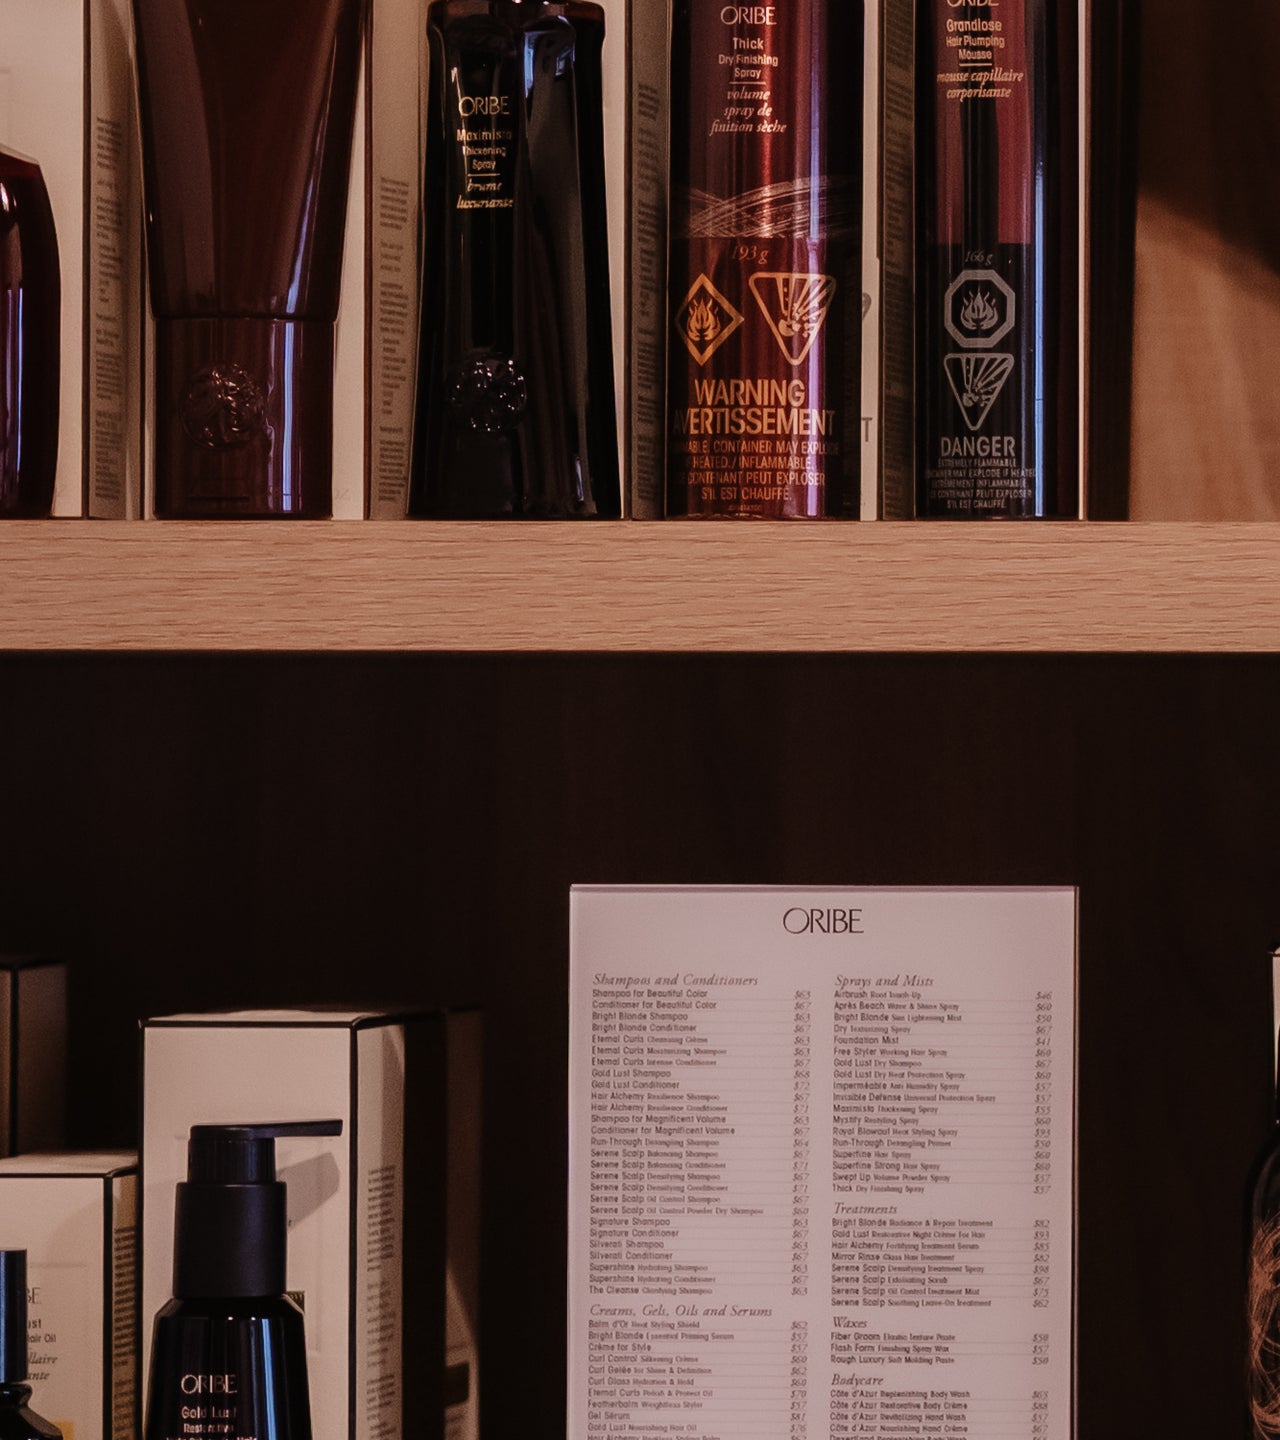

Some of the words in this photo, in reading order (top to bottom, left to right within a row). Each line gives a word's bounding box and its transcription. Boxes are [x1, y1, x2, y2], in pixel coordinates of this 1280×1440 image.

[720, 6, 777, 26] ORIBE
[946, 18, 1003, 33] Grandiose
[732, 37, 764, 51] Thick
[946, 35, 962, 48] Hair
[963, 35, 1006, 49] Plumping
[718, 54, 734, 66] Dry
[736, 53, 778, 68] Finishing
[958, 49, 993, 61] Mousse
[734, 67, 761, 80] Spray
[936, 71, 969, 83] mousse
[970, 67, 1025, 87] capillaire
[726, 87, 771, 101] volume
[946, 84, 1012, 103] corporisante
[458, 96, 510, 117] ORIBE
[723, 106, 755, 120] spray
[757, 104, 773, 118] de
[709, 120, 754, 137] finition
[755, 120, 788, 134] sèche
[472, 160, 496, 170] Spray
[694, 378, 806, 408] WARNING
[940, 435, 1017, 458] DANGER
[782, 906, 865, 935] ORIBE
[592, 973, 651, 988] Shampoos
[654, 972, 681, 987] and
[682, 972, 759, 987] Conditioners
[833, 974, 872, 991] Sprays
[874, 974, 901, 988] and
[901, 974, 935, 988] Mists
[592, 989, 632, 999] Shampoo
[632, 989, 645, 998] for
[647, 988, 685, 998] Beautiful
[685, 988, 709, 998] Color
[833, 1201, 899, 1215] Treatments
[590, 1304, 637, 1318] Creams,
[641, 1303, 670, 1318] Gels,
[674, 1303, 700, 1318] Oils
[702, 1303, 728, 1318] and
[731, 1303, 774, 1318] Serums
[832, 1316, 869, 1329] Waxes
[181, 1374, 238, 1394] ORIBE
[831, 1373, 885, 1389] Bodycare
